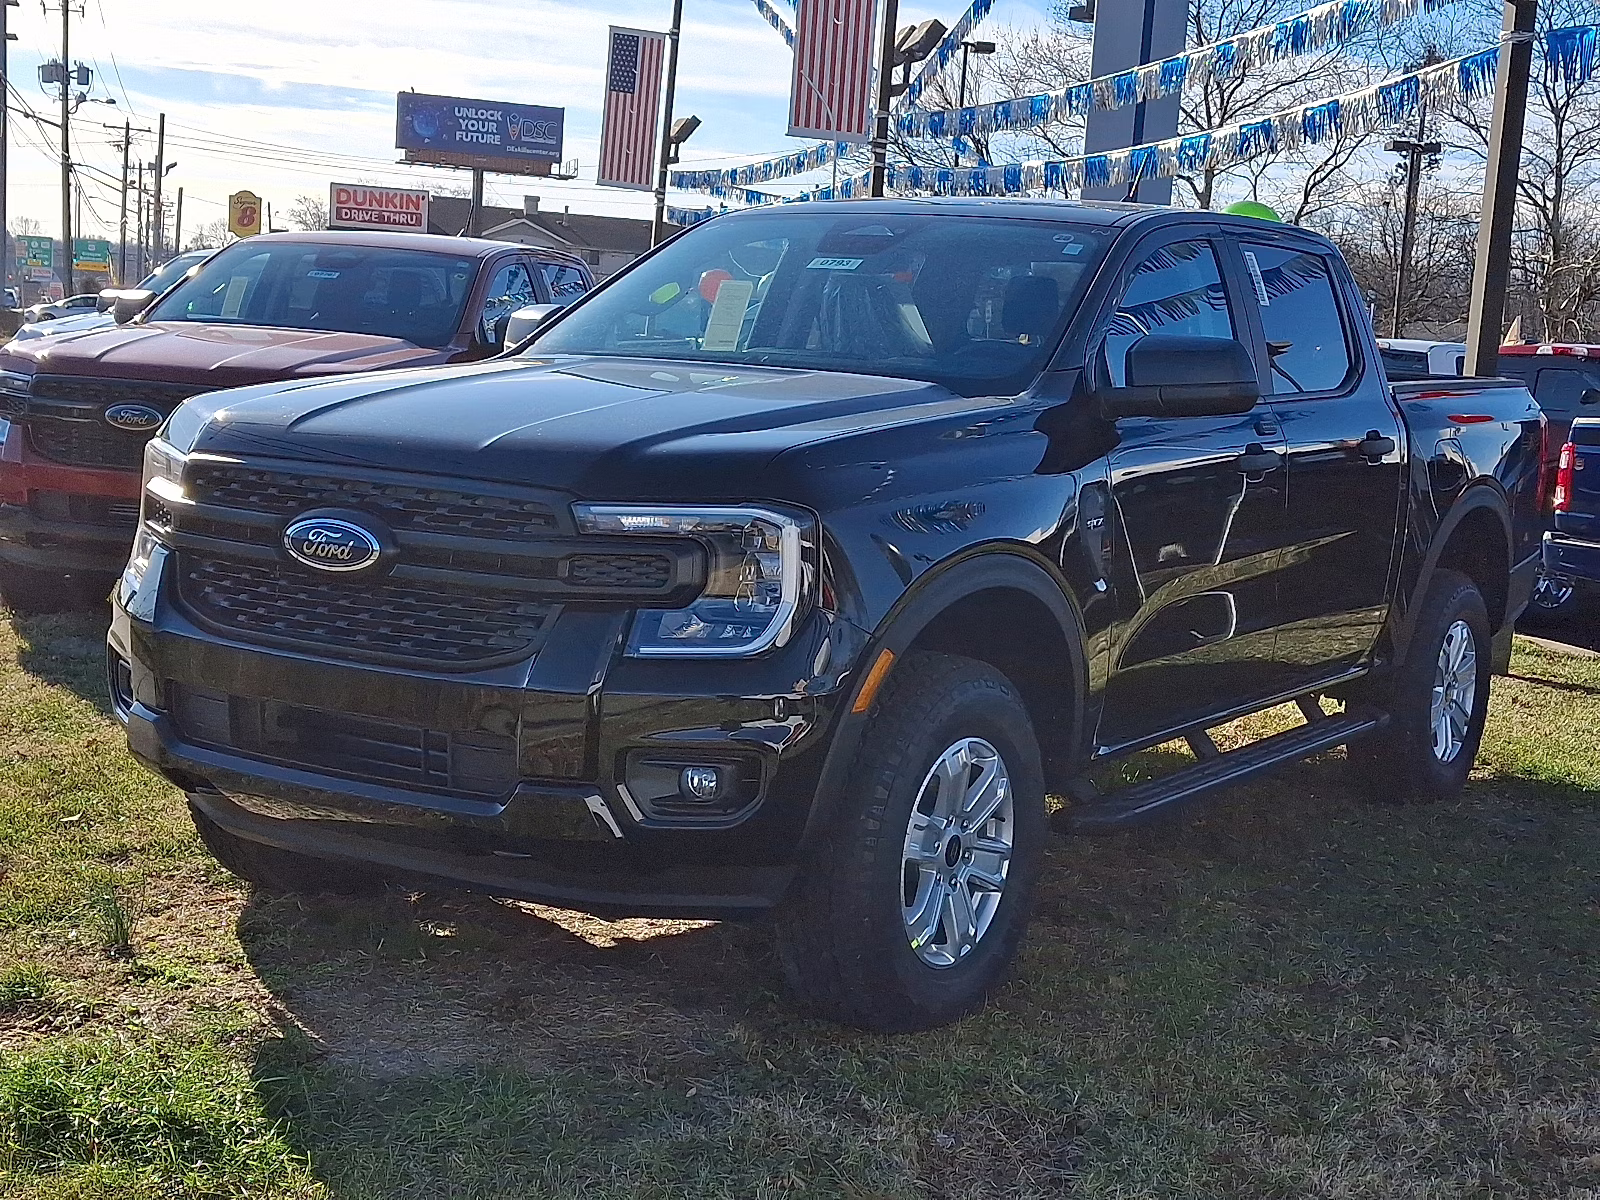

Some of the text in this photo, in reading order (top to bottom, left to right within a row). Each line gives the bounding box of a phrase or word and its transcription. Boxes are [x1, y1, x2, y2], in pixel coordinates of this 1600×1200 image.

[454, 106, 503, 121] UNLOCK
[459, 118, 498, 134] YOUR
[522, 119, 557, 141] DSC
[455, 130, 501, 145] FUTURE
[336, 188, 425, 211] DUNKIN'
[237, 206, 257, 228] 8
[341, 208, 417, 225] DRIVE THRU
[819, 259, 852, 267] 0793
[117, 409, 149, 426] Ford
[302, 528, 355, 561] Ford
